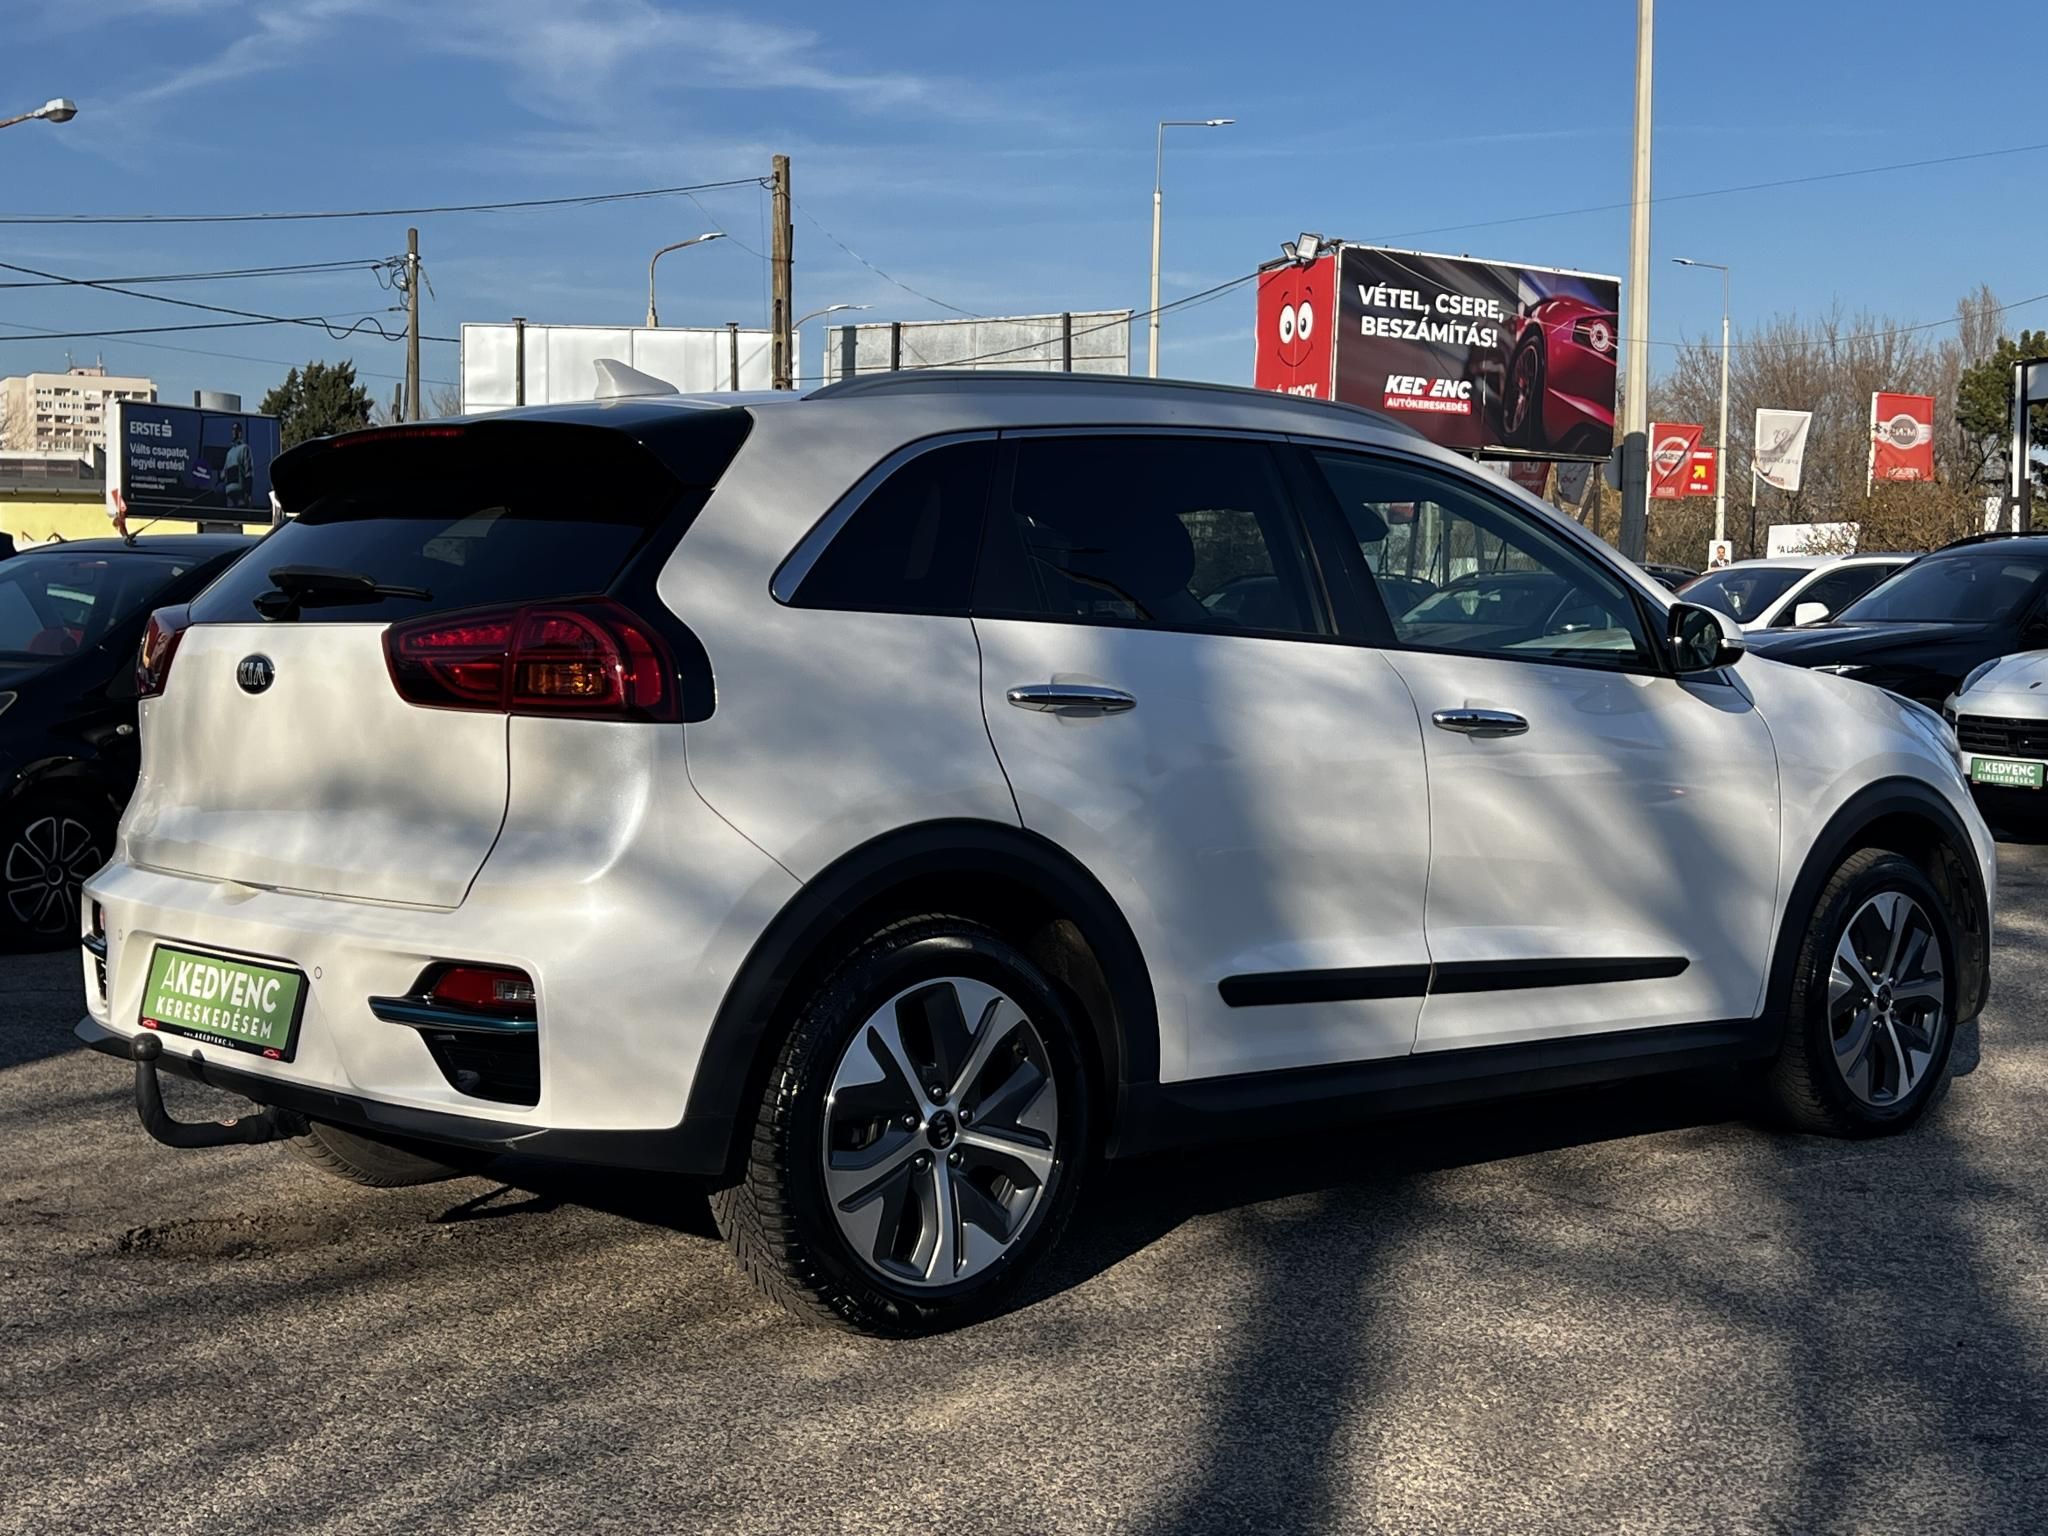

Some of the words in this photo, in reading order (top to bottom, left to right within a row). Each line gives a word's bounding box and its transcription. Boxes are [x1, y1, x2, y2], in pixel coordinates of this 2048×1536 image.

[1358, 284, 1430, 314] VÉTEL,
[1435, 293, 1504, 323] CSERE,
[1361, 316, 1498, 348] BESZÁMÍTÁS!
[1386, 397, 1469, 413] AUTÓKERESKEDÉS
[130, 421, 161, 437] ERSTE
[130, 442, 151, 455] Válts
[152, 447, 190, 460] csapatot,
[240, 662, 266, 685] KIA
[1978, 761, 2035, 777] AKEDVENC
[160, 956, 281, 1013] AKEDVENC
[156, 994, 273, 1039] KERESKEDÉSEM
